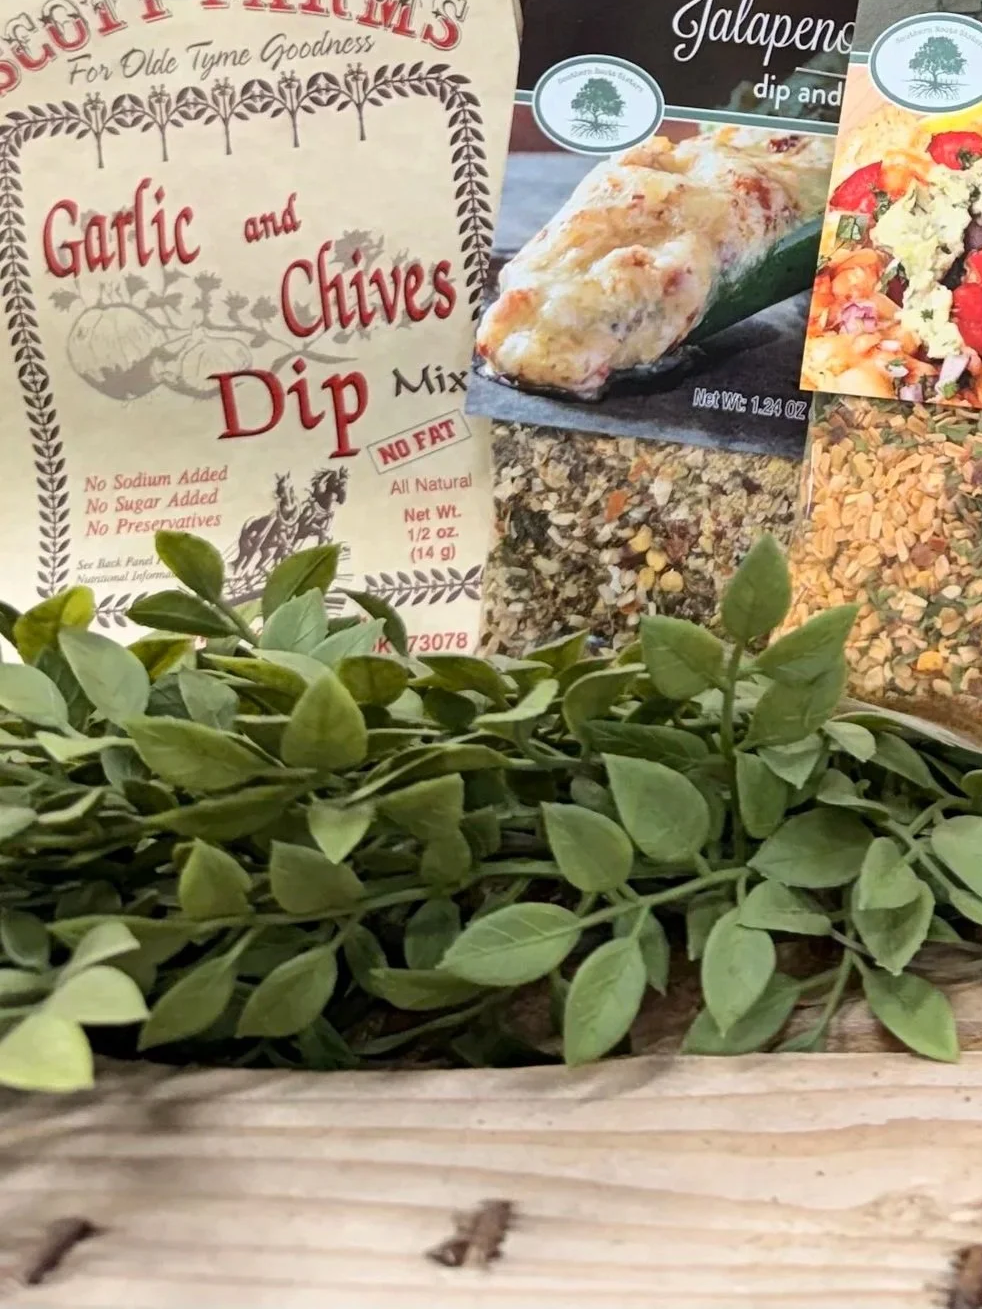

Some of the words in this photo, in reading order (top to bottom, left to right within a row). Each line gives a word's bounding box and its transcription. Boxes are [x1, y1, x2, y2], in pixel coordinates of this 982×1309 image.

[67, 53, 113, 85] For
[120, 47, 178, 79] Olde
[187, 40, 252, 81] Tyme
[260, 30, 375, 67] Goodness
[753, 75, 790, 106] dip
[797, 78, 842, 107] and
[43, 177, 201, 279] Garlic
[244, 192, 302, 245] and
[281, 240, 458, 339] Chives
[207, 358, 371, 460] Dip
[392, 364, 468, 397] Mix
[693, 387, 720, 409] Net
[722, 391, 747, 413] Wt:
[751, 395, 782, 418] 1.24
[785, 399, 808, 421] OZ
[377, 438, 411, 466] NO
[412, 418, 457, 452] FAT
[84, 475, 108, 493] No
[112, 472, 172, 491] Sodium
[178, 465, 229, 485] Added
[390, 480, 410, 496] All
[415, 473, 474, 493] Natural
[85, 498, 109, 515] No
[114, 495, 164, 515] Sugar
[167, 488, 219, 508] Added
[404, 507, 431, 524] Net
[435, 503, 462, 521] Wt.
[86, 520, 110, 538] No
[116, 513, 223, 536] Preservatives
[408, 526, 432, 542] 1/2
[436, 525, 460, 540] oz.
[125, 555, 154, 569] Panel
[410, 546, 435, 564] (14
[440, 543, 457, 562] g)
[372, 635, 392, 655] K
[407, 631, 469, 654] 73078
